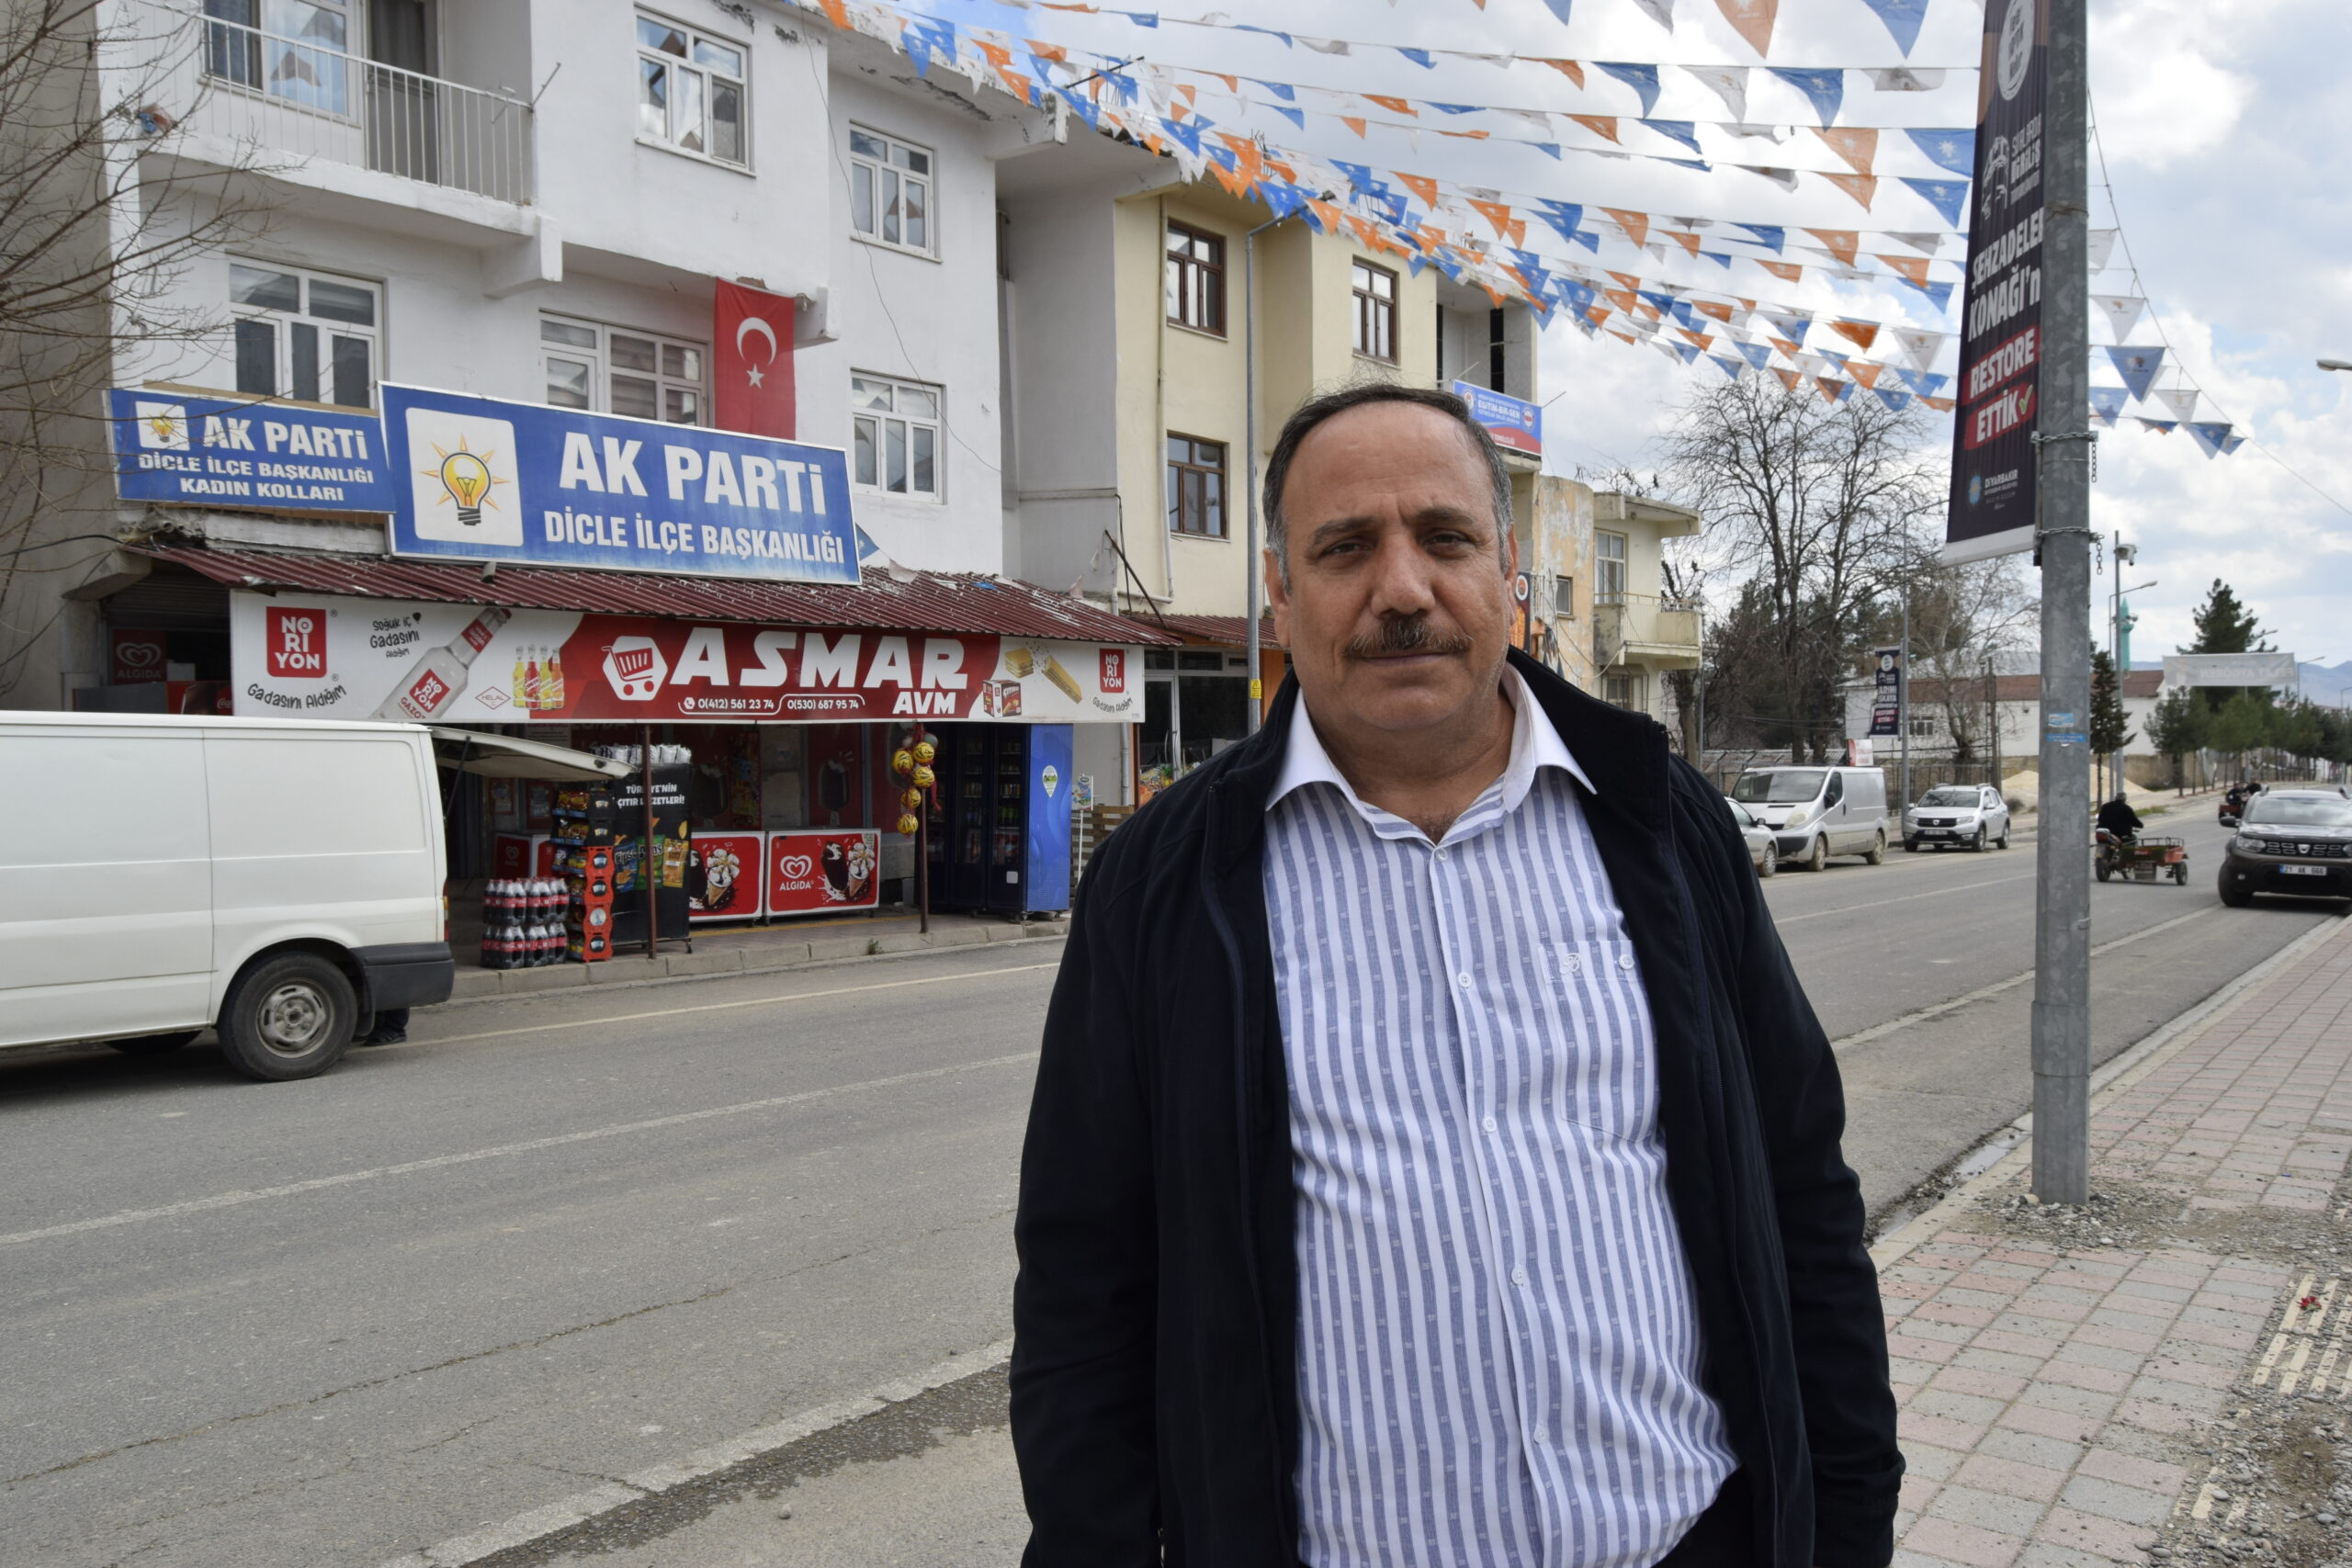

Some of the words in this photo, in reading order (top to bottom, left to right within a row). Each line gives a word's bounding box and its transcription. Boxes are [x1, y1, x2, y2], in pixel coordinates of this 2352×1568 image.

[1969, 327, 2036, 399] RESTORE
[1976, 387, 2018, 443] ETTİK
[202, 415, 256, 452] AK
[263, 420, 368, 459] PARTİ
[138, 451, 201, 473] DİCLE
[207, 455, 253, 477] İLÇE
[258, 461, 374, 484] BAŞKANLIĞI
[559, 431, 648, 497] AK
[663, 444, 827, 515] PARTİ
[179, 477, 251, 497] KADIN
[257, 482, 345, 502] KOLLARI
[544, 504, 628, 547] DİCLE
[634, 512, 695, 556] İLÇE
[701, 524, 844, 564] BAŞKANLIĞI
[369, 630, 420, 649] Gadasını
[275, 652, 321, 670] YON
[669, 626, 968, 691] ASMAR
[730, 698, 747, 709] 561
[749, 698, 762, 709] 23
[763, 698, 775, 709] 74
[818, 699, 834, 710] 687
[836, 699, 847, 710] 95
[848, 699, 860, 710] 74
[891, 691, 956, 715] AVM
[626, 782, 678, 795] TÜRYE'NİN
[616, 796, 639, 809] ÇITIR
[639, 794, 685, 807] LZETLERİ!
